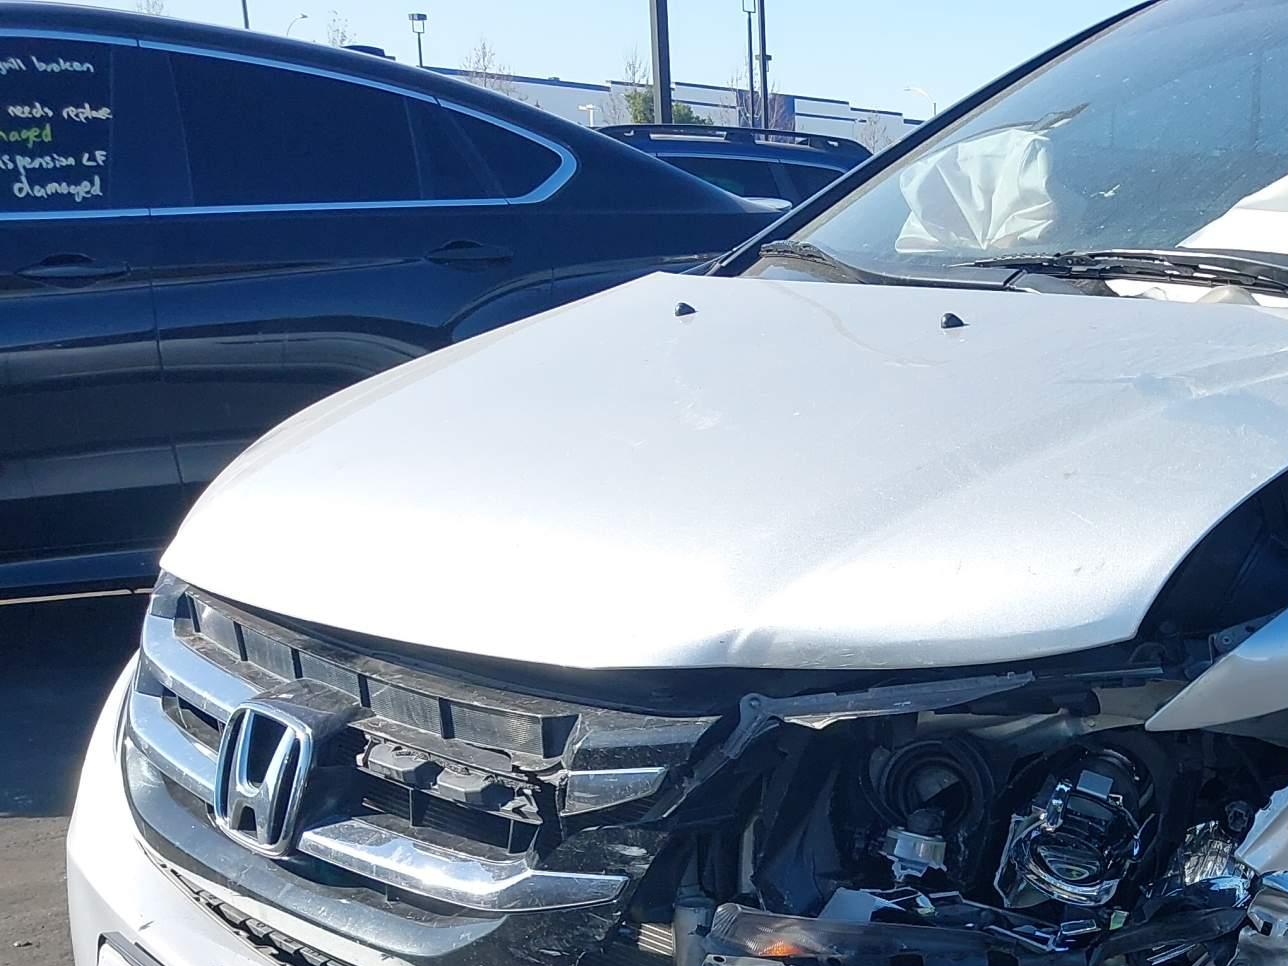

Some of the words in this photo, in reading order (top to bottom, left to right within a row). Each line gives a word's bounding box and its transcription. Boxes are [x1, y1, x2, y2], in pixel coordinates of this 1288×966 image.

[31, 55, 95, 73] broken
[7, 101, 54, 118] needs
[82, 150, 107, 166] LF
[13, 175, 103, 202] damaged
